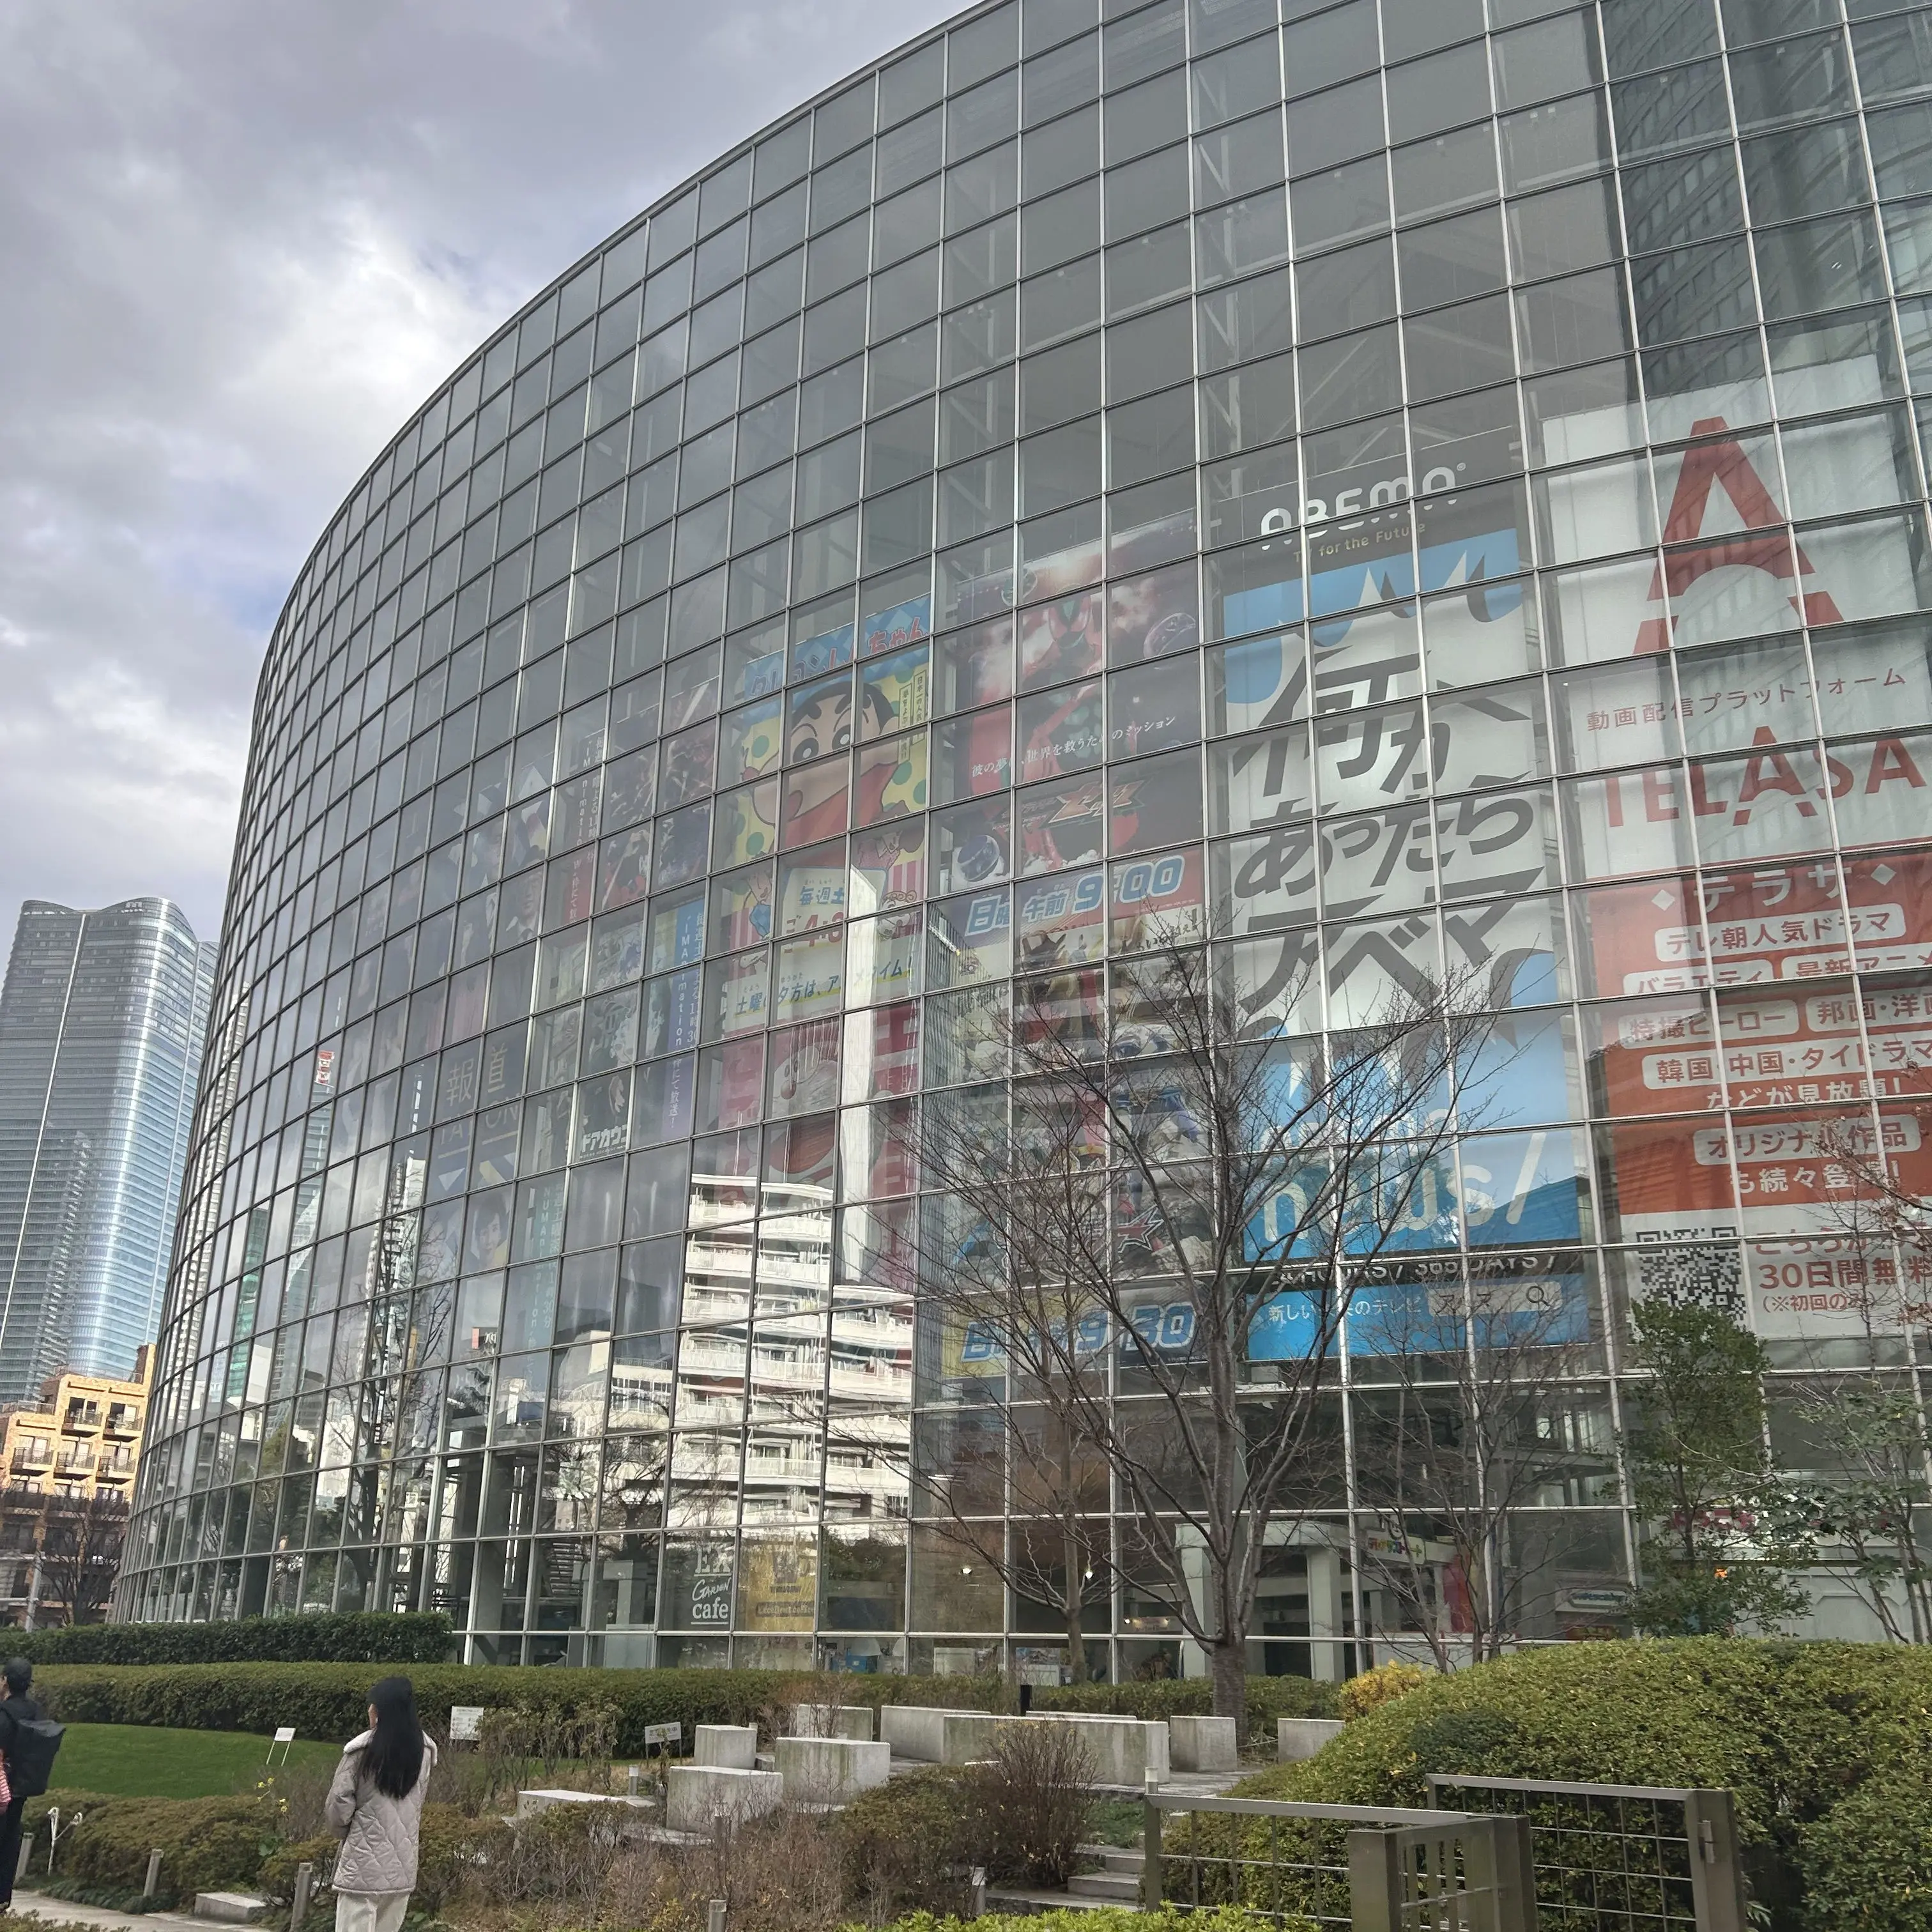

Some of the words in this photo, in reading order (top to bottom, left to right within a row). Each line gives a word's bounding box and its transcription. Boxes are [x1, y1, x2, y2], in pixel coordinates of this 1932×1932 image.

[1318, 542, 1342, 557] for
[1346, 536, 1370, 551] the
[1376, 522, 1426, 544] Futue
[972, 716, 1176, 778] 彼の夢、世界を救うたのミッション
[1232, 645, 1531, 797] 何か
[1234, 771, 1534, 899] あったら
[1238, 866, 1545, 1016] アベマ
[1666, 912, 1891, 955] テレ朝人気ドラマ
[1268, 1298, 1422, 1324] 新しいのテレビ
[692, 1597, 730, 1620] cafe
